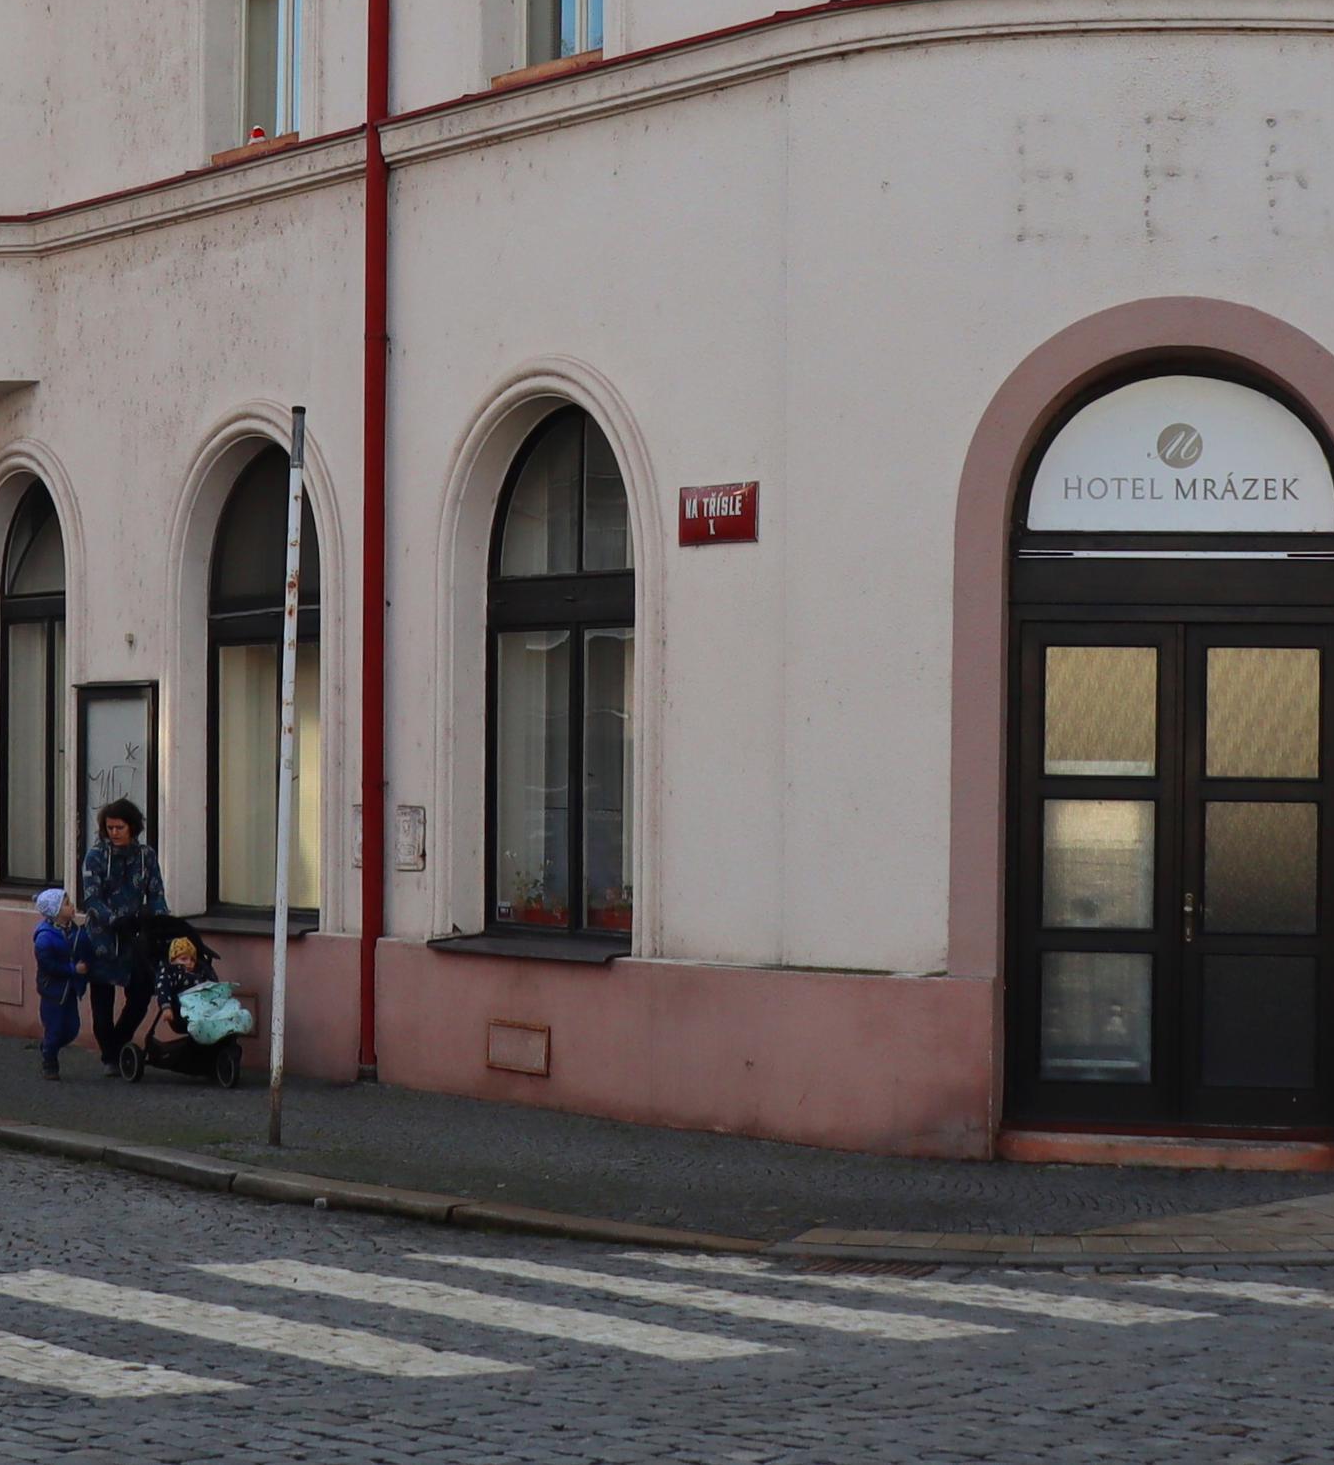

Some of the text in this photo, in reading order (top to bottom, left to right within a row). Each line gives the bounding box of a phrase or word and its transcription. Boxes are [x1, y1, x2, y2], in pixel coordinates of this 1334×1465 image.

[1062, 471, 1301, 502] HOTEL MRÁZEK
[685, 491, 743, 520] NA TŘÍSLE
